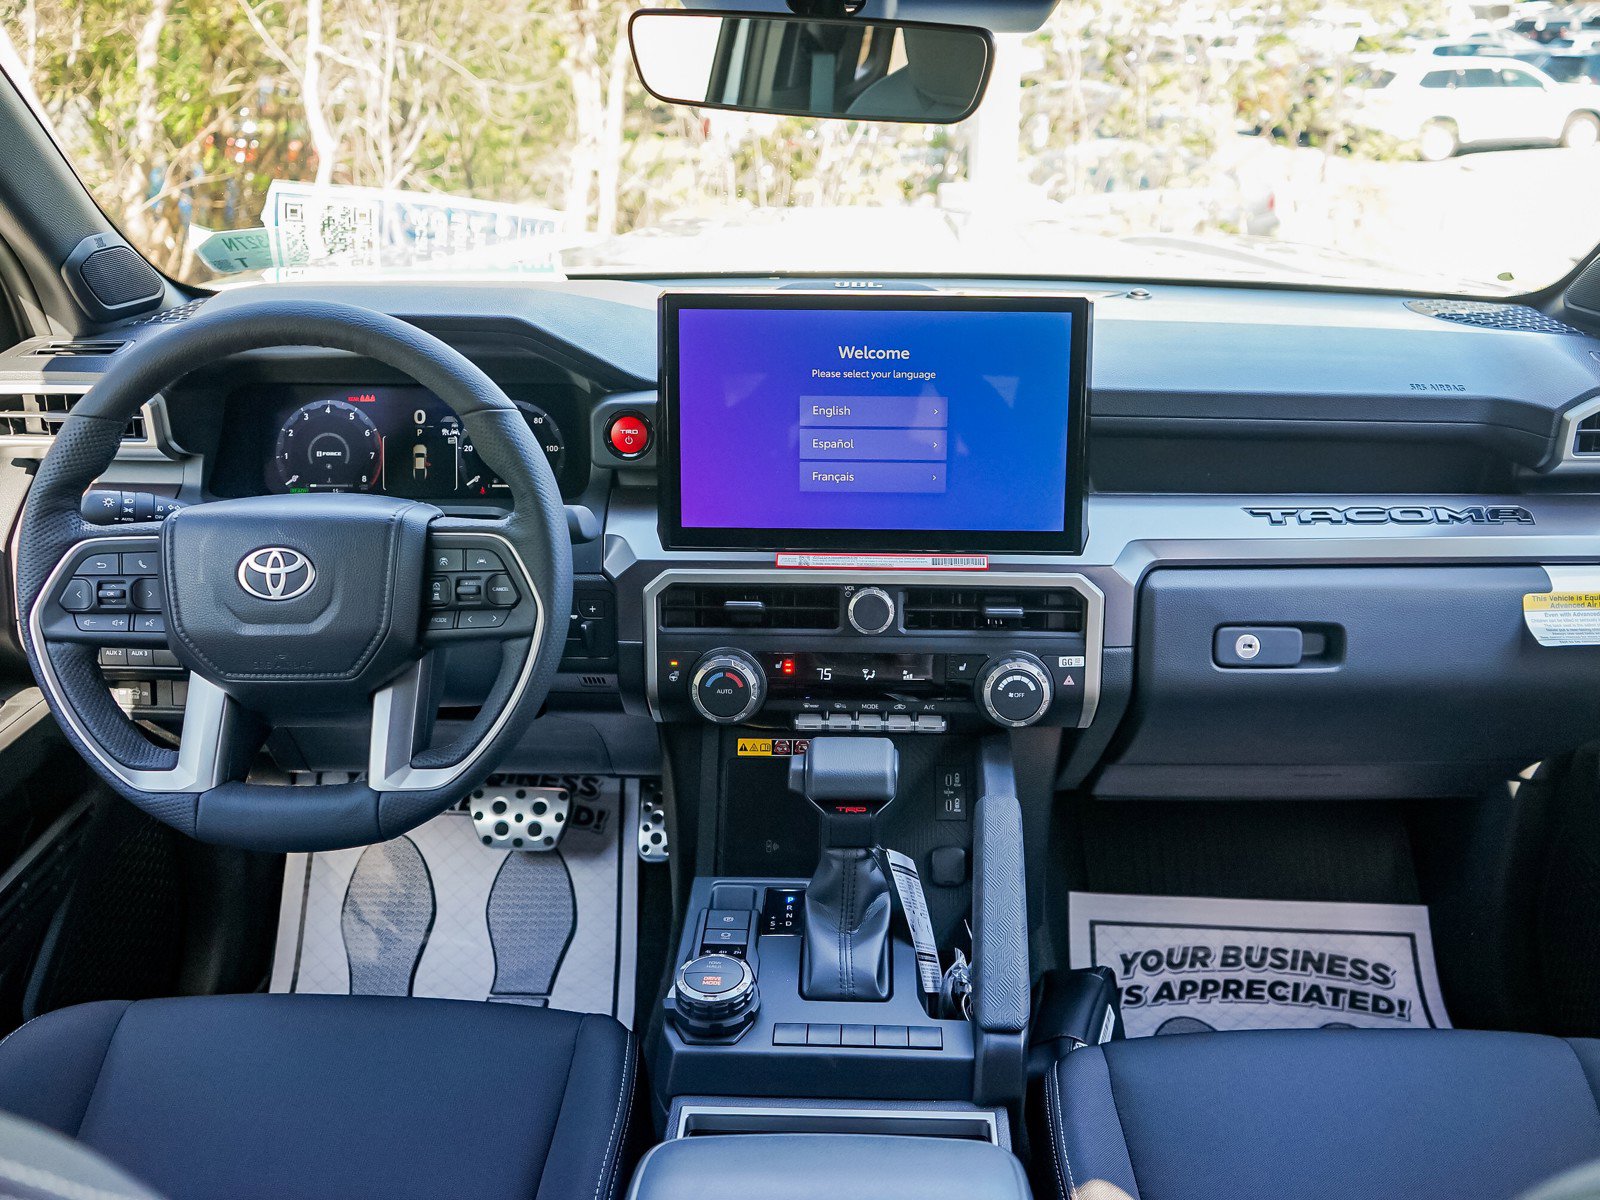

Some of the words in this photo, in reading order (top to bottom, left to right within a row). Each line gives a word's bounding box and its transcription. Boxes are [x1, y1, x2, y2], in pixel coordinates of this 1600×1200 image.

[838, 345, 910, 360] Welcome
[811, 369, 841, 378] Please
[843, 369, 869, 378] select
[871, 371, 891, 380] your
[893, 370, 936, 380] language
[1409, 383, 1427, 391] SRS
[1429, 383, 1467, 392] AIRBAG
[325, 406, 331, 414] 4
[812, 405, 851, 418] English
[303, 413, 309, 421] 3
[349, 412, 355, 420] 5
[413, 409, 426, 425] 0
[288, 429, 294, 437] 2
[364, 429, 370, 437] 6
[416, 428, 423, 437] P
[463, 444, 474, 452] 20
[812, 438, 854, 451] Español
[284, 452, 288, 460] 1
[370, 452, 375, 460] 7
[361, 475, 367, 483] 8
[812, 471, 854, 484] Français
[1242, 505, 1537, 527] TACOMA
[1061, 658, 1073, 666] GG
[816, 668, 832, 681] 75
[1119, 945, 1213, 977] YOUR
[1220, 945, 1396, 986] BUSINESS
[1150, 979, 1409, 1018] APPRECIATED!
